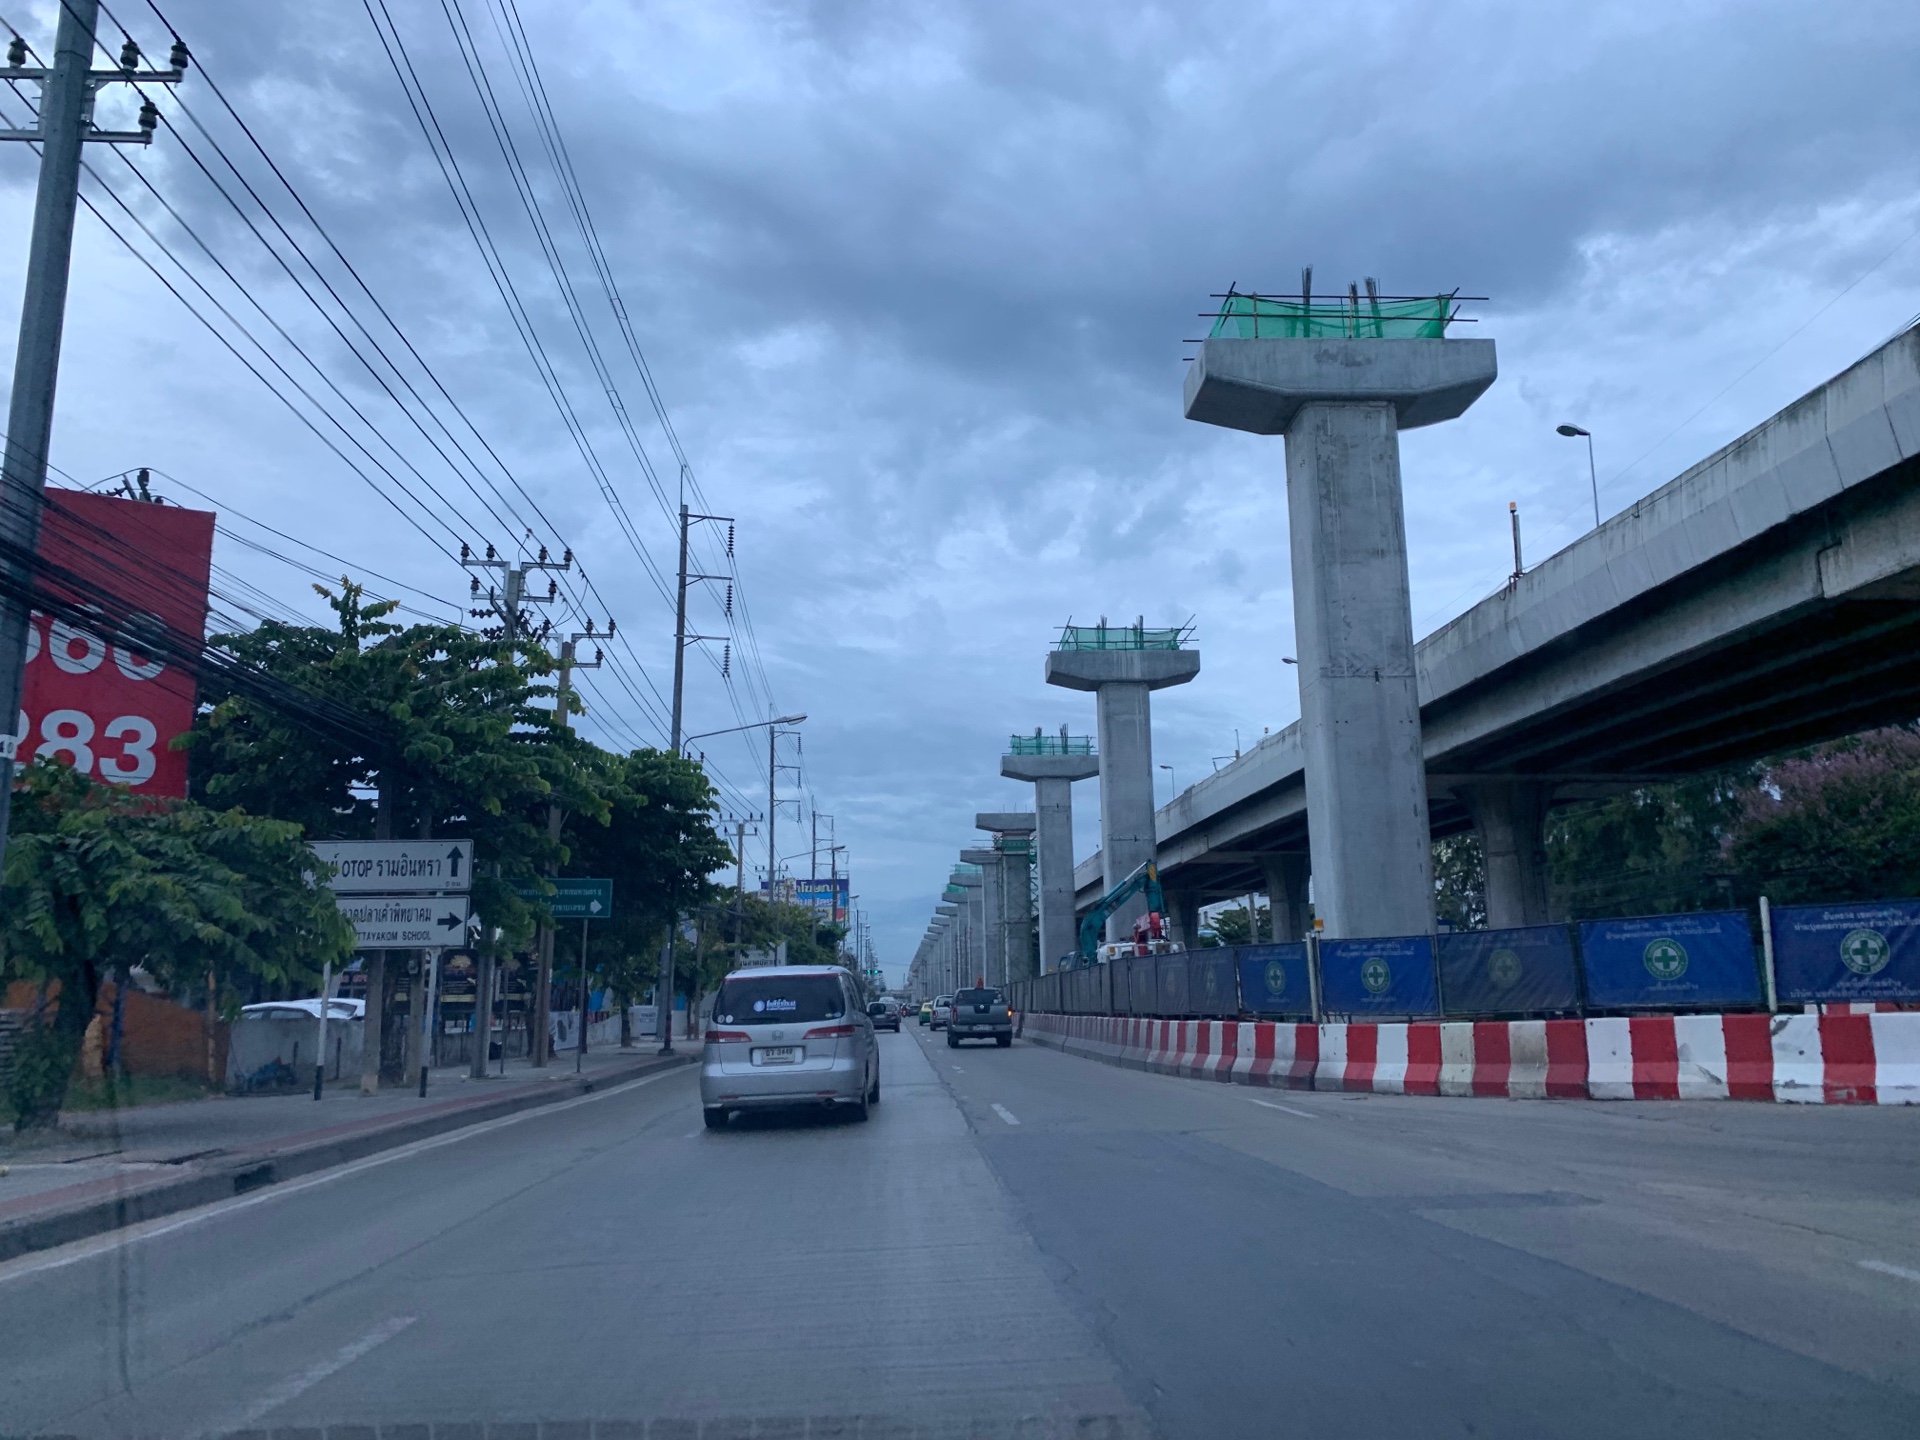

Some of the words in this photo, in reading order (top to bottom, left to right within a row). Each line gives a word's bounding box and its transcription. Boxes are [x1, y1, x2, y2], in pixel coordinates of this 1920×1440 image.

[14, 708, 157, 786] 83
[342, 860, 373, 878] OTOP
[376, 853, 442, 878] รามอินทรา
[402, 931, 432, 941] SCHOOL
